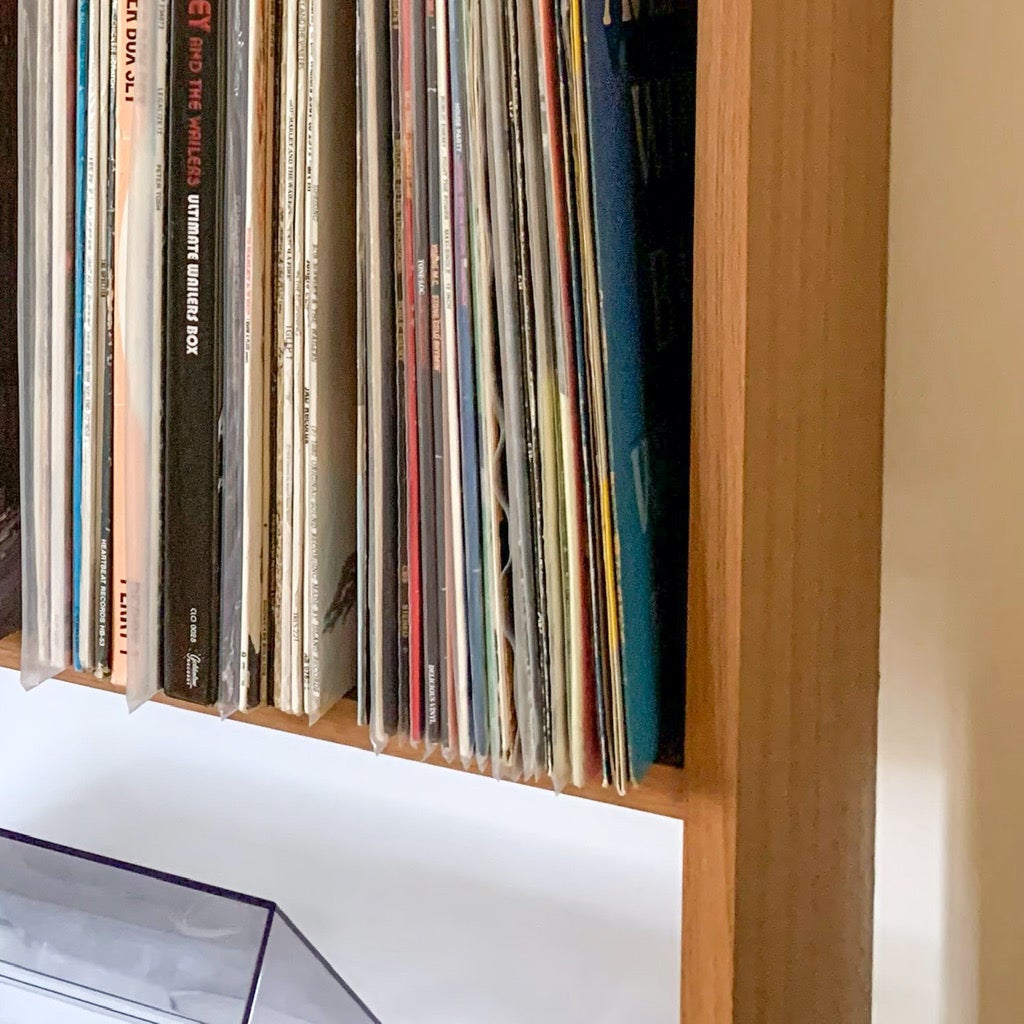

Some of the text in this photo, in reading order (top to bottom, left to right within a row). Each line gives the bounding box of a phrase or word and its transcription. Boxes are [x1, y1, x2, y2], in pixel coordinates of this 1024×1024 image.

[188, 37, 204, 74] AND
[187, 80, 203, 111] THE
[454, 102, 463, 153] HOUSE PARTY
[186, 116, 203, 188] WAILERS
[155, 164, 163, 189] PETER
[186, 194, 200, 260] ULTIMATE
[185, 263, 200, 323] WAILERS
[185, 325, 199, 356] BOX
[99, 538, 108, 584] HEARTBEAT
[98, 585, 107, 624] RECORDS
[428, 664, 436, 725] DELICIOUS VINYL
